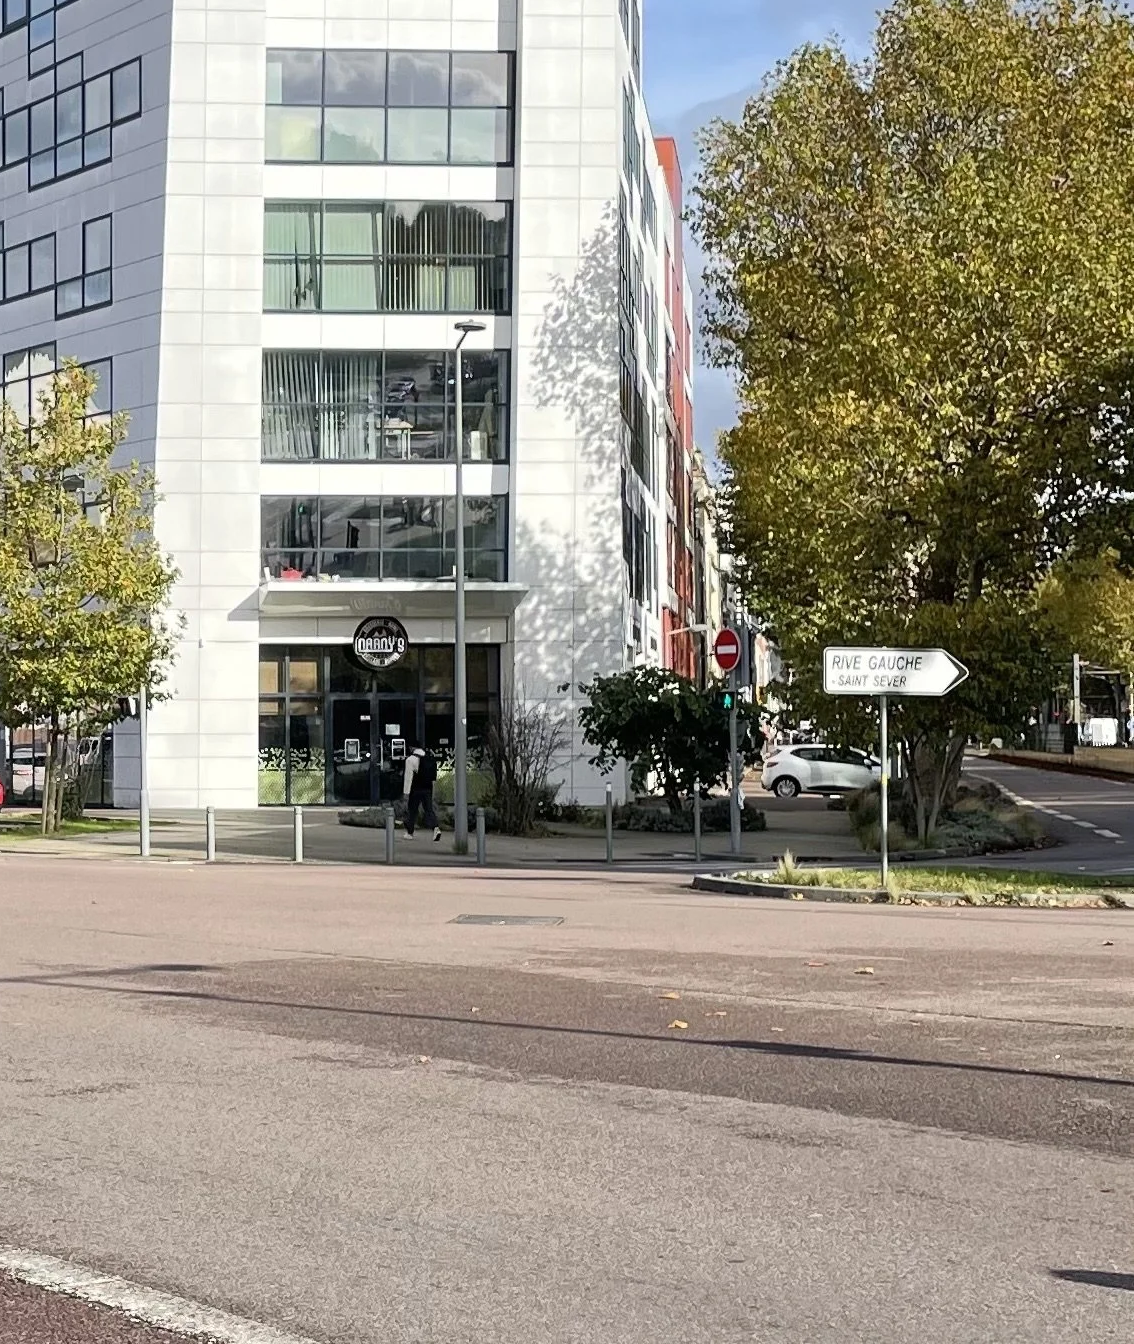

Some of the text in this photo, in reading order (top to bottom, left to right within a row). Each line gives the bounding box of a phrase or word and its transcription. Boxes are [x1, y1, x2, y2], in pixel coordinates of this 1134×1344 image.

[832, 655, 923, 671] RIVE GAUCHE
[838, 675, 907, 688] SAINT SEVER
